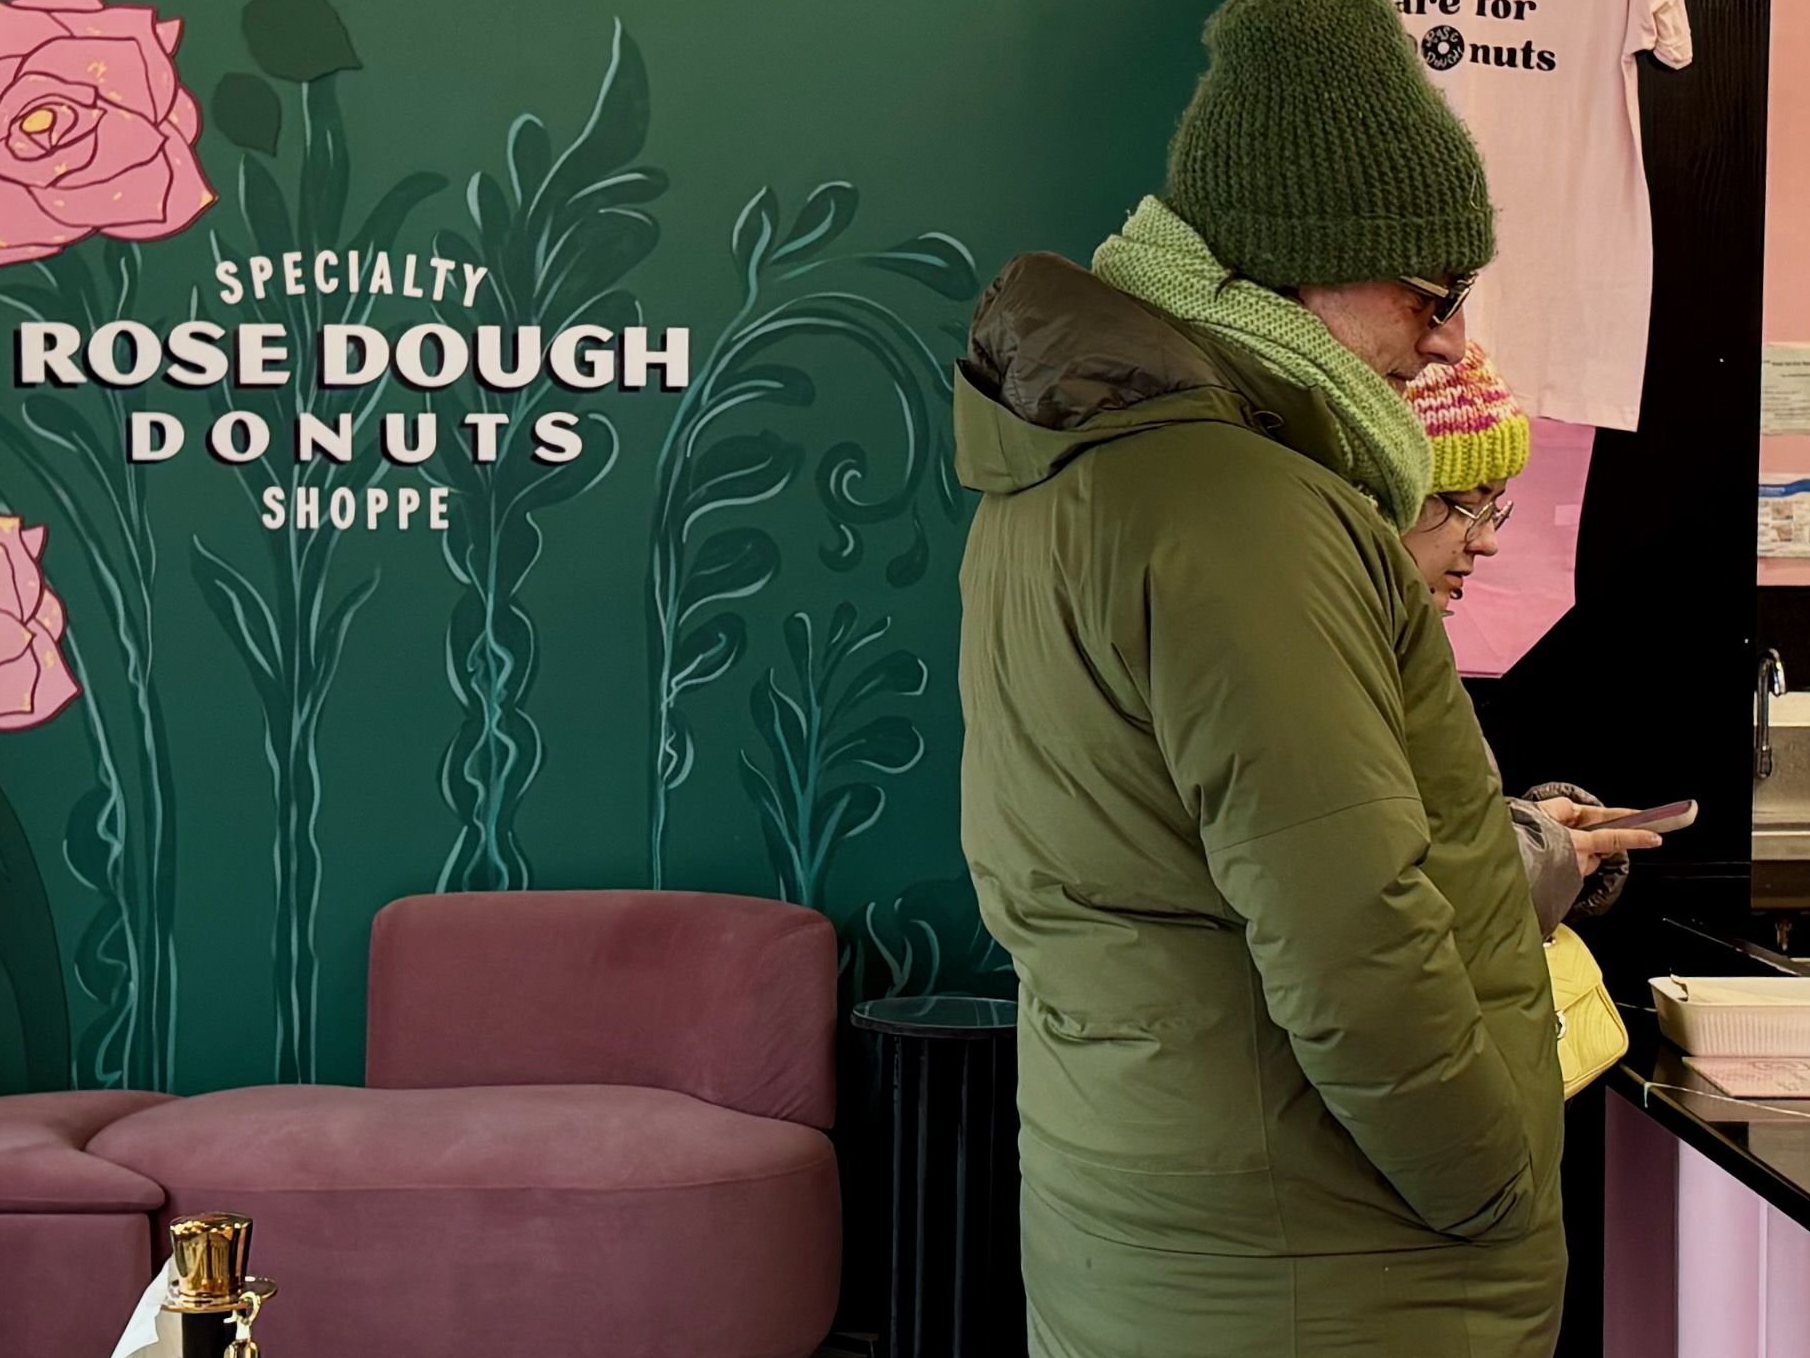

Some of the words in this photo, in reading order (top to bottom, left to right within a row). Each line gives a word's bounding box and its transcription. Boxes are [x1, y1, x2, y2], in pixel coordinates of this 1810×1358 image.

[215, 250, 489, 308] SPECIALTY
[14, 320, 291, 388] ROSE
[321, 322, 690, 390] DOUGH
[130, 411, 584, 464] DONUTS
[261, 486, 450, 531] SHOPPE
